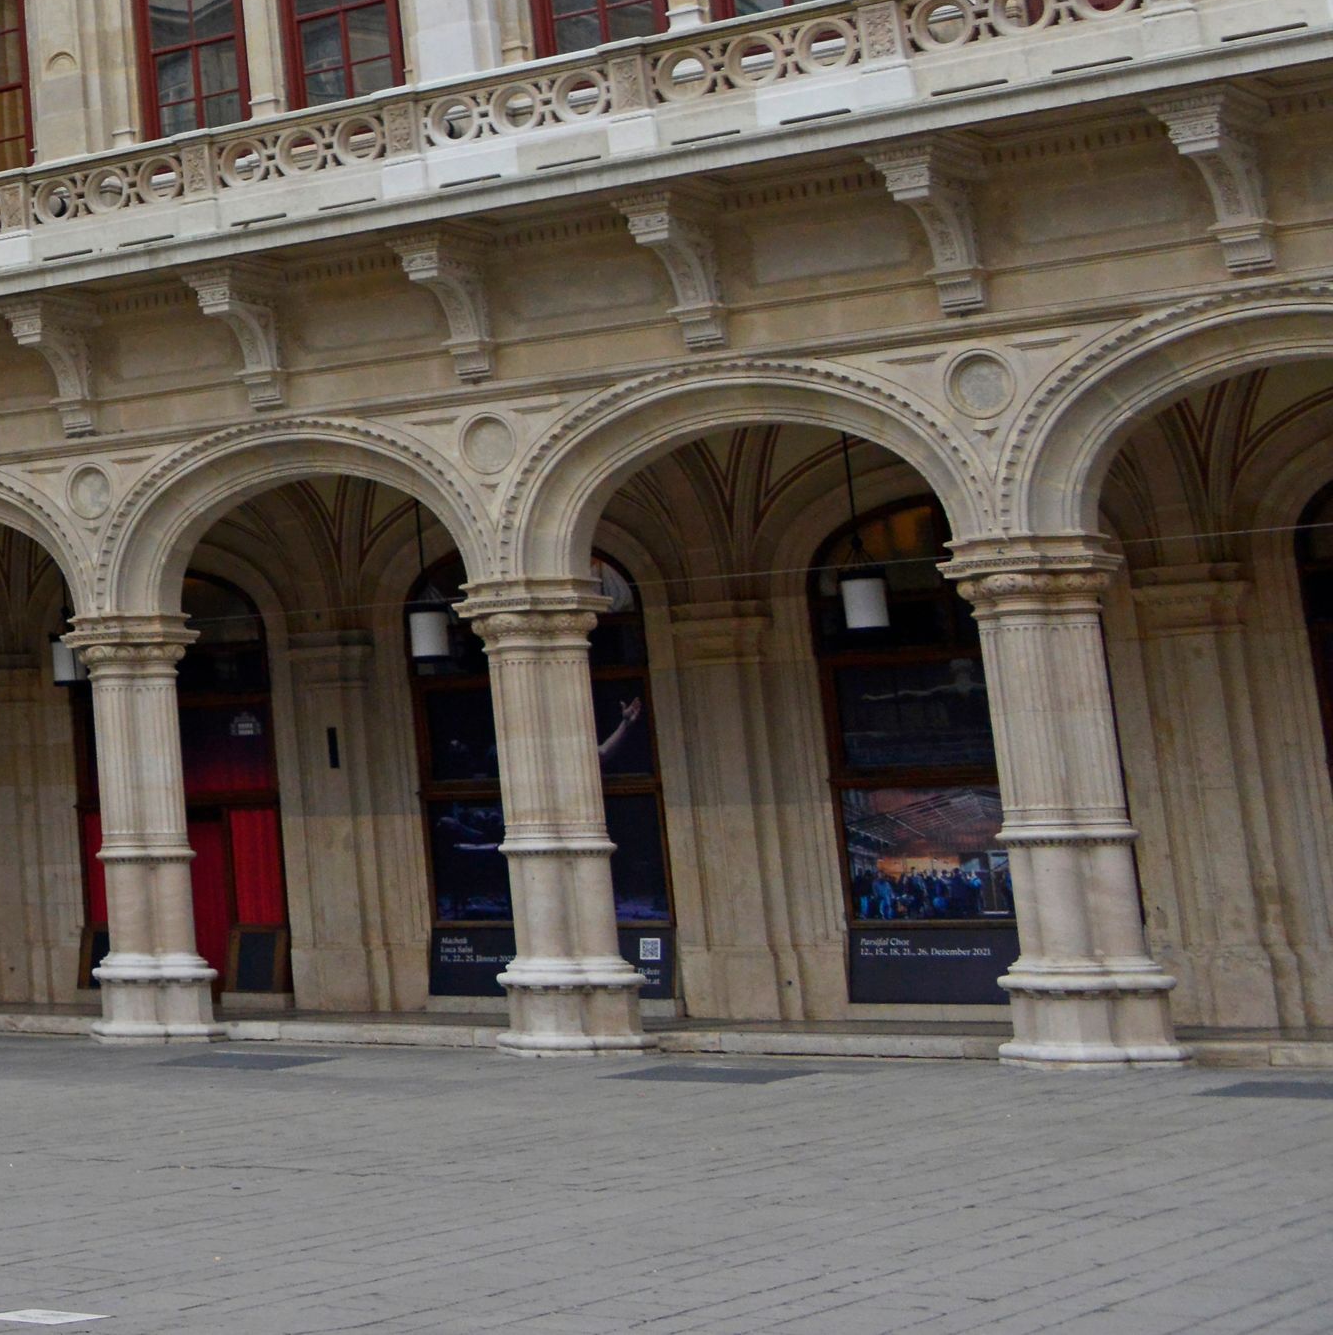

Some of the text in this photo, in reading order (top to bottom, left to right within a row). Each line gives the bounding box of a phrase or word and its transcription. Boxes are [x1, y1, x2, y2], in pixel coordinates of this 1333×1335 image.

[860, 938, 889, 947] Parsifal
[931, 948, 971, 956] Dezember
[973, 948, 991, 956] 2021
